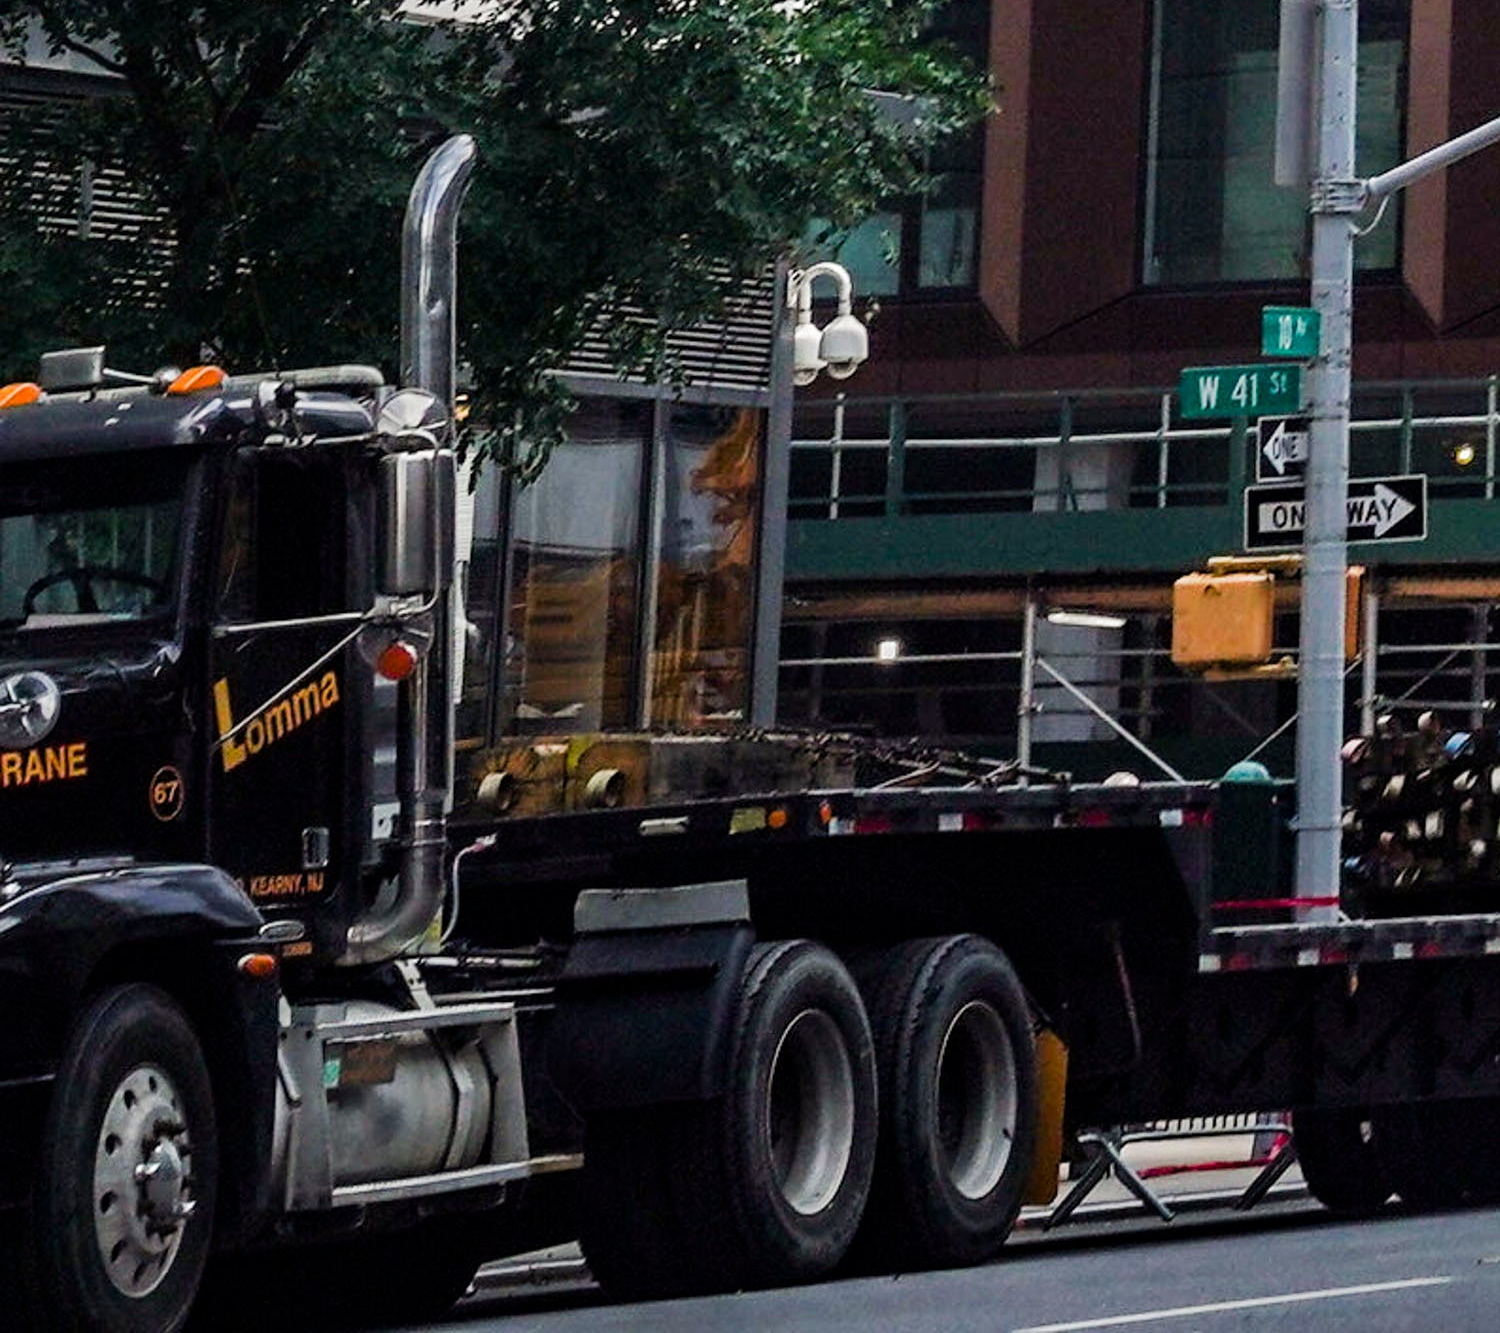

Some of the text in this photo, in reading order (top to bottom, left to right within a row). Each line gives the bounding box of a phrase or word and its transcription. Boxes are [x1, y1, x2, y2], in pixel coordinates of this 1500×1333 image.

[1278, 315, 1293, 350] 10
[1199, 371, 1288, 410] W 41 St
[1272, 503, 1306, 529] ON
[213, 671, 340, 773] Lomma
[0, 742, 88, 787] RANE
[153, 782, 178, 805] 67
